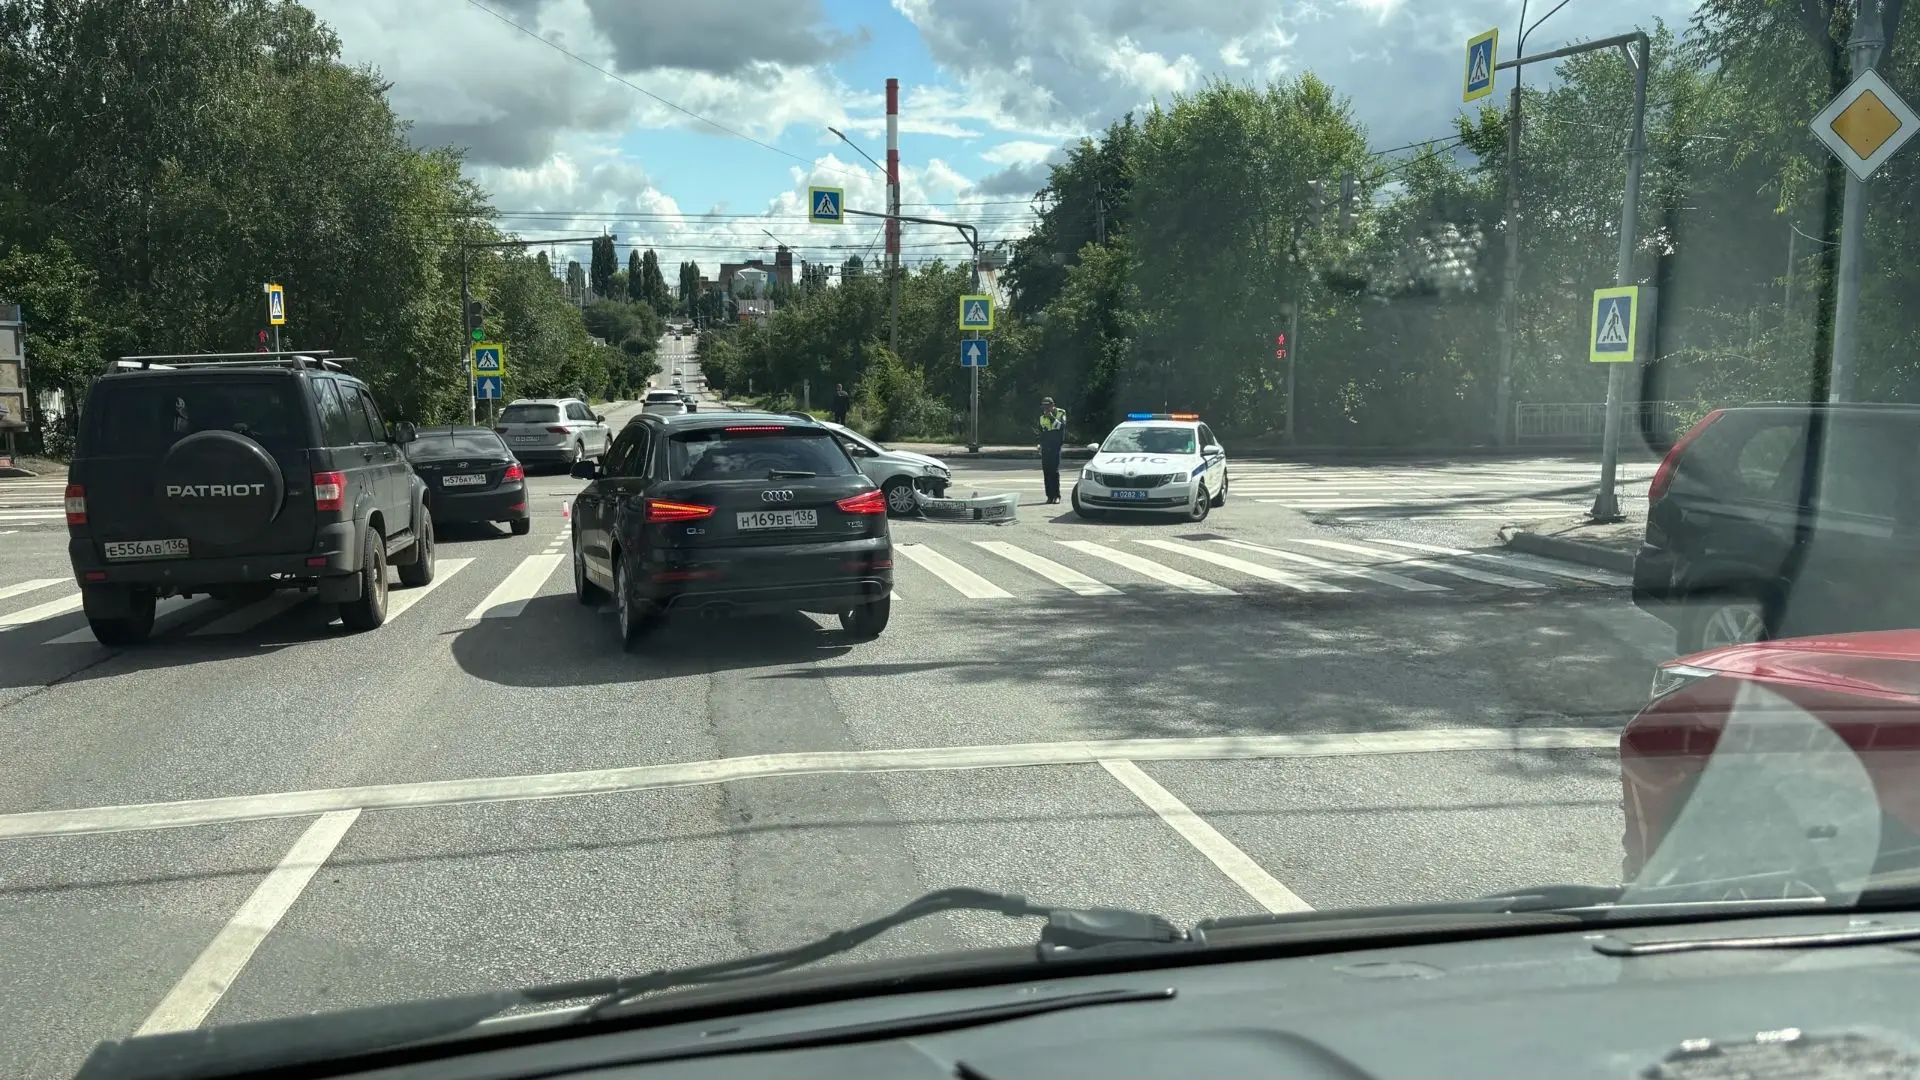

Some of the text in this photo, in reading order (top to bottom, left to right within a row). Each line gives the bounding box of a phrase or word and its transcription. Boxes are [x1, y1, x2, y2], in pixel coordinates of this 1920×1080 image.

[1105, 456, 1169, 465] ДПС
[166, 484, 265, 497] PATRIOT
[742, 510, 814, 527] Н169ВЕ 136
[109, 539, 186, 556] Е556АВ 136
